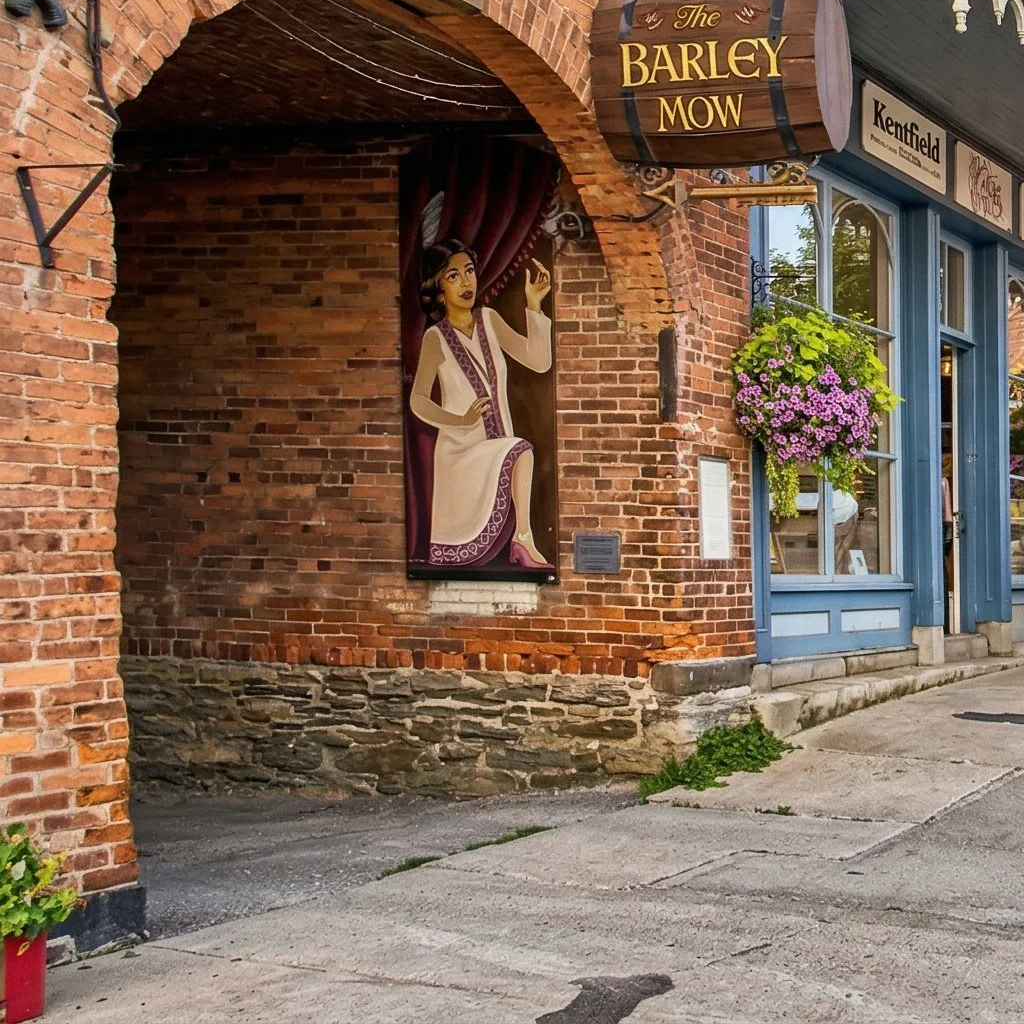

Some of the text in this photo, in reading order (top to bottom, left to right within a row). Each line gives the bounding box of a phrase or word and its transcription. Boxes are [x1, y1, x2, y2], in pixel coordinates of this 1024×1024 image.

[673, 3, 722, 29] The
[618, 35, 789, 88] BARLEY
[657, 93, 744, 132] MOW
[872, 97, 941, 165] Kentfield
